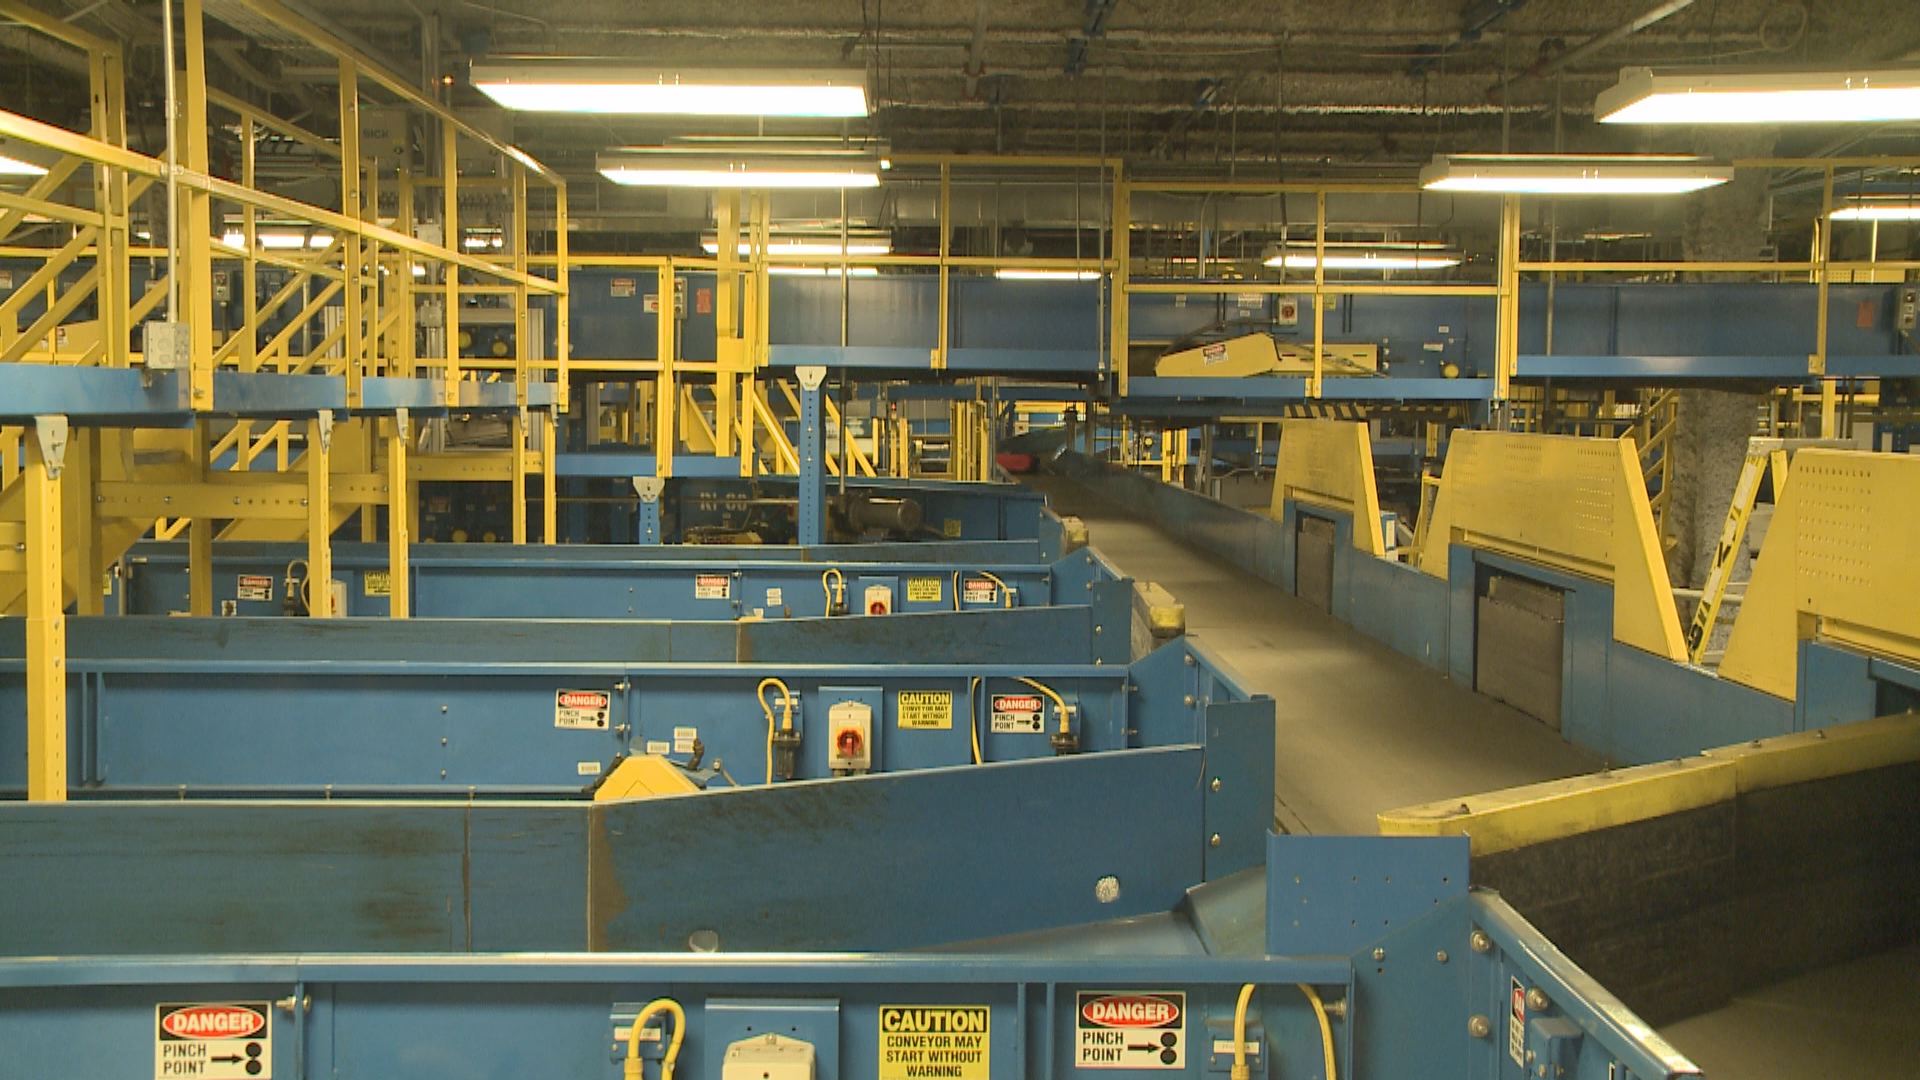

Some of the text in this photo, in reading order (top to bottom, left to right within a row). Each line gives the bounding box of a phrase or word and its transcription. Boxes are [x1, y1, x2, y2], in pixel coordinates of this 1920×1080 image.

[564, 695, 603, 707] DANGER
[901, 693, 950, 704] CAUTION
[999, 699, 1037, 711] DANGER
[1092, 1002, 1169, 1021] DANGER
[172, 1012, 255, 1033] DANGER
[884, 1009, 985, 1032] CAUTION
[887, 1035, 982, 1047] CONVEYOR MAY
[1082, 1031, 1124, 1045] PINCH
[163, 1043, 207, 1057] PINCH
[886, 1050, 982, 1063] START WITHOUT
[1082, 1048, 1123, 1061] POINT
[163, 1060, 206, 1074] POINT
[906, 1065, 962, 1077] WARNING
